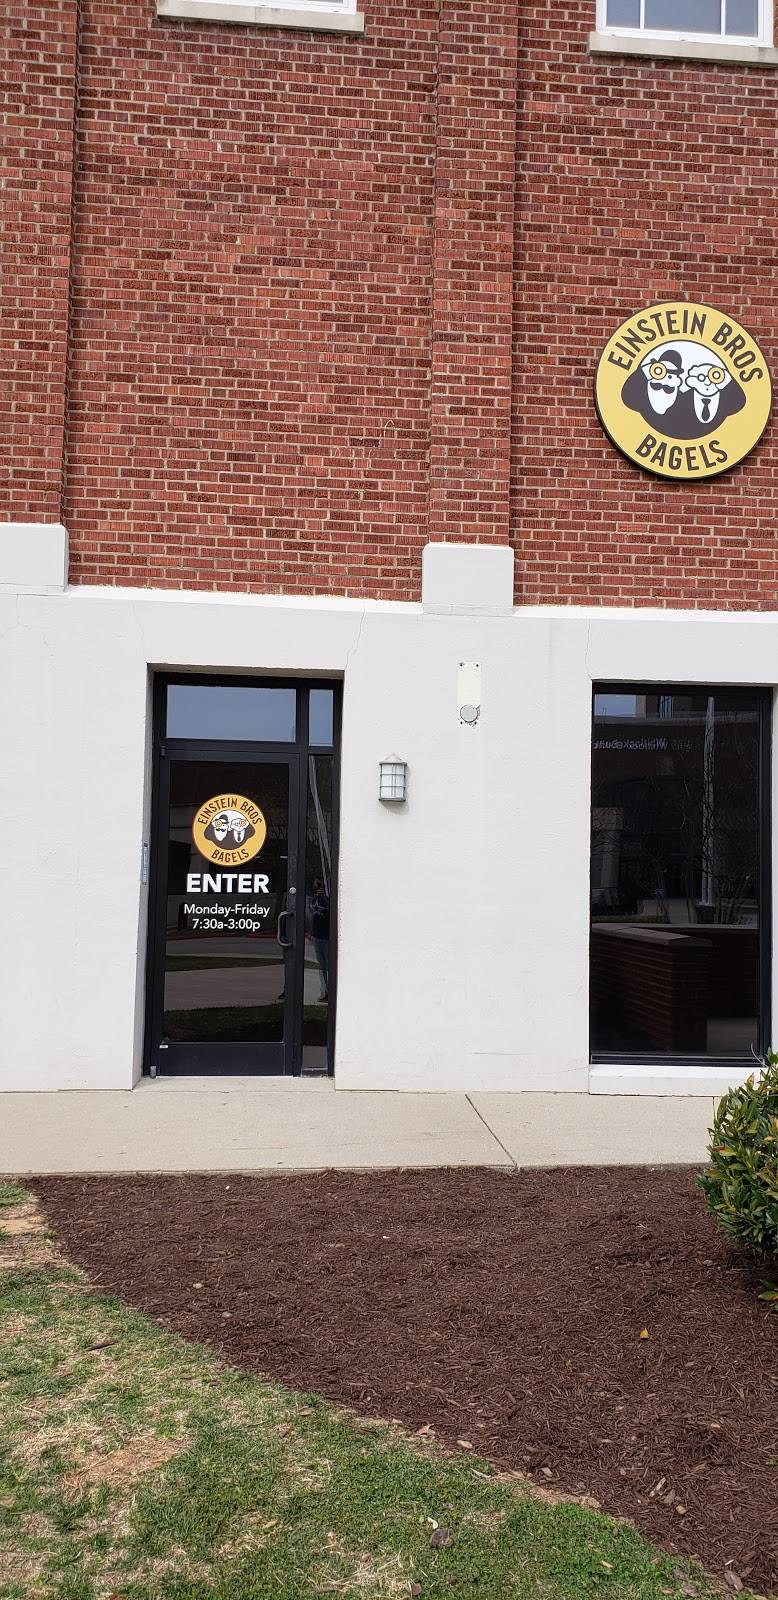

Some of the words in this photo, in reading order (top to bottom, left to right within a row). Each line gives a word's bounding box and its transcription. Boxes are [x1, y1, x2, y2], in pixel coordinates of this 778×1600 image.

[607, 310, 707, 371] EINSTEIN
[711, 322, 763, 383] BROS
[635, 433, 728, 471] BAGELS
[198, 798, 238, 825] EINSTEIN
[240, 801, 262, 825] BROS
[211, 849, 250, 863] BAGELS
[186, 873, 270, 894] ENTER
[183, 903, 270, 918] Monday-Friday
[192, 918, 261, 932] 7:30a-3:00p
